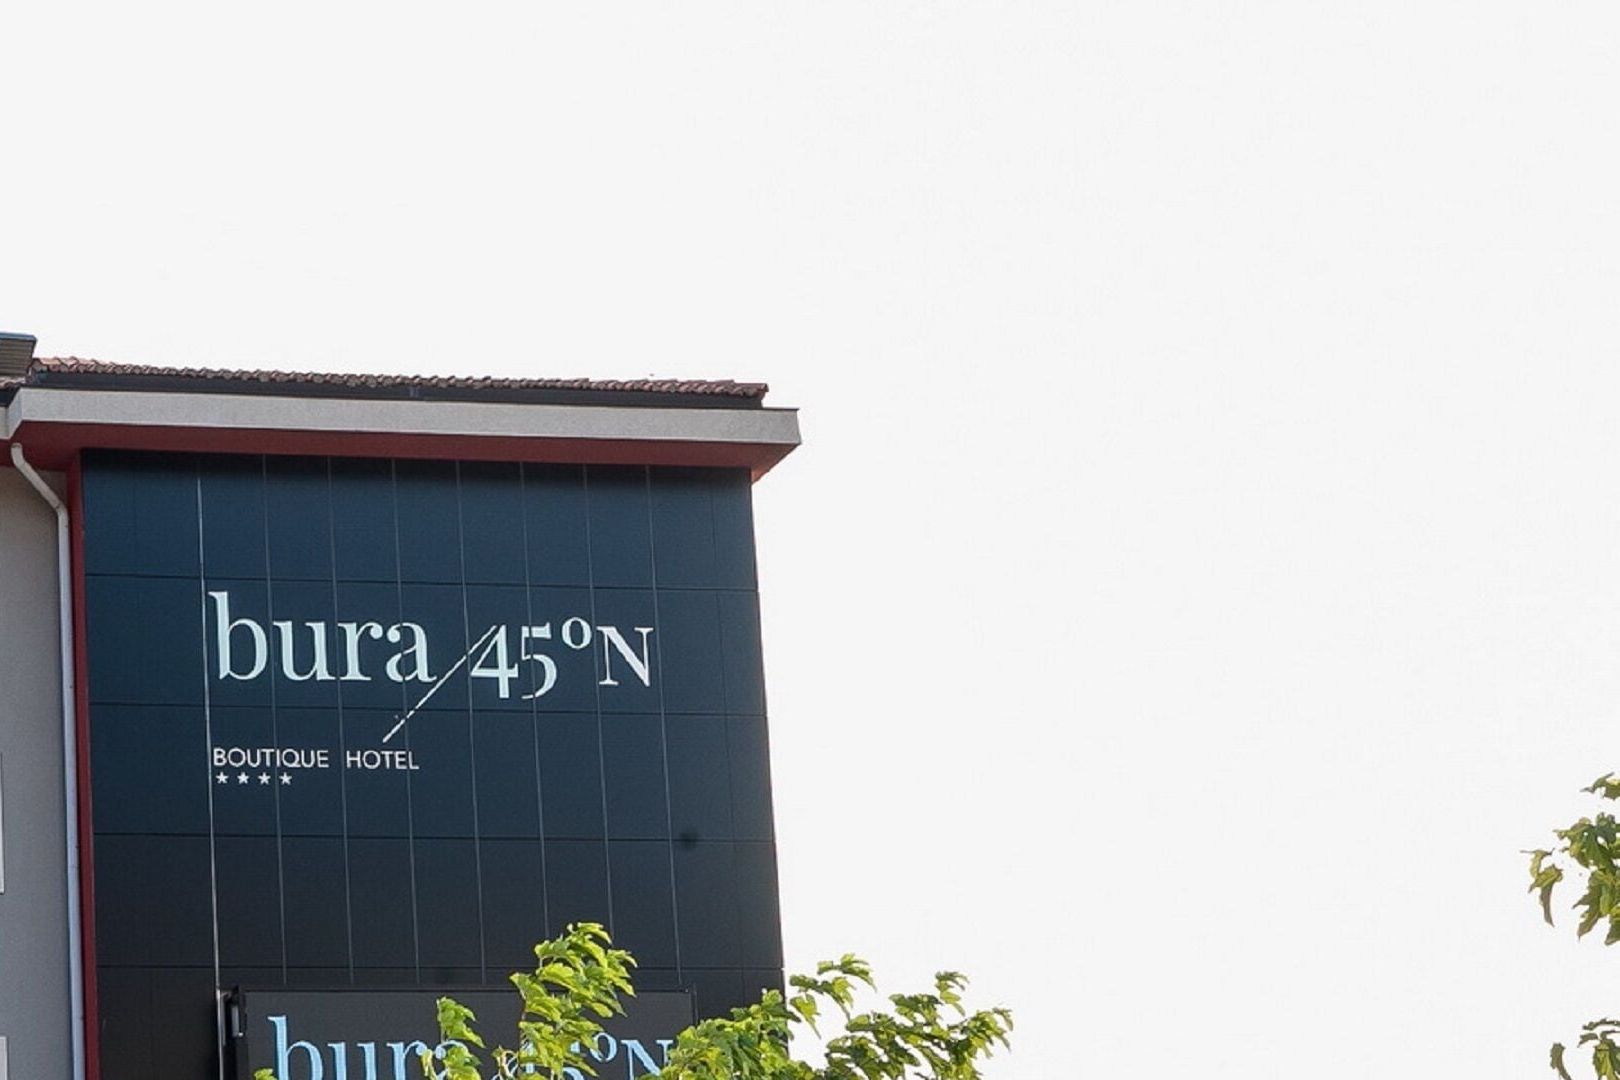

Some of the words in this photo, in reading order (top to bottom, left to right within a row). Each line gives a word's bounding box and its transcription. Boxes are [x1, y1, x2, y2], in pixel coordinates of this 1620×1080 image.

[208, 590, 438, 684] bura
[213, 747, 329, 768] BOUTIQUE
[346, 750, 420, 770] HOTEL
